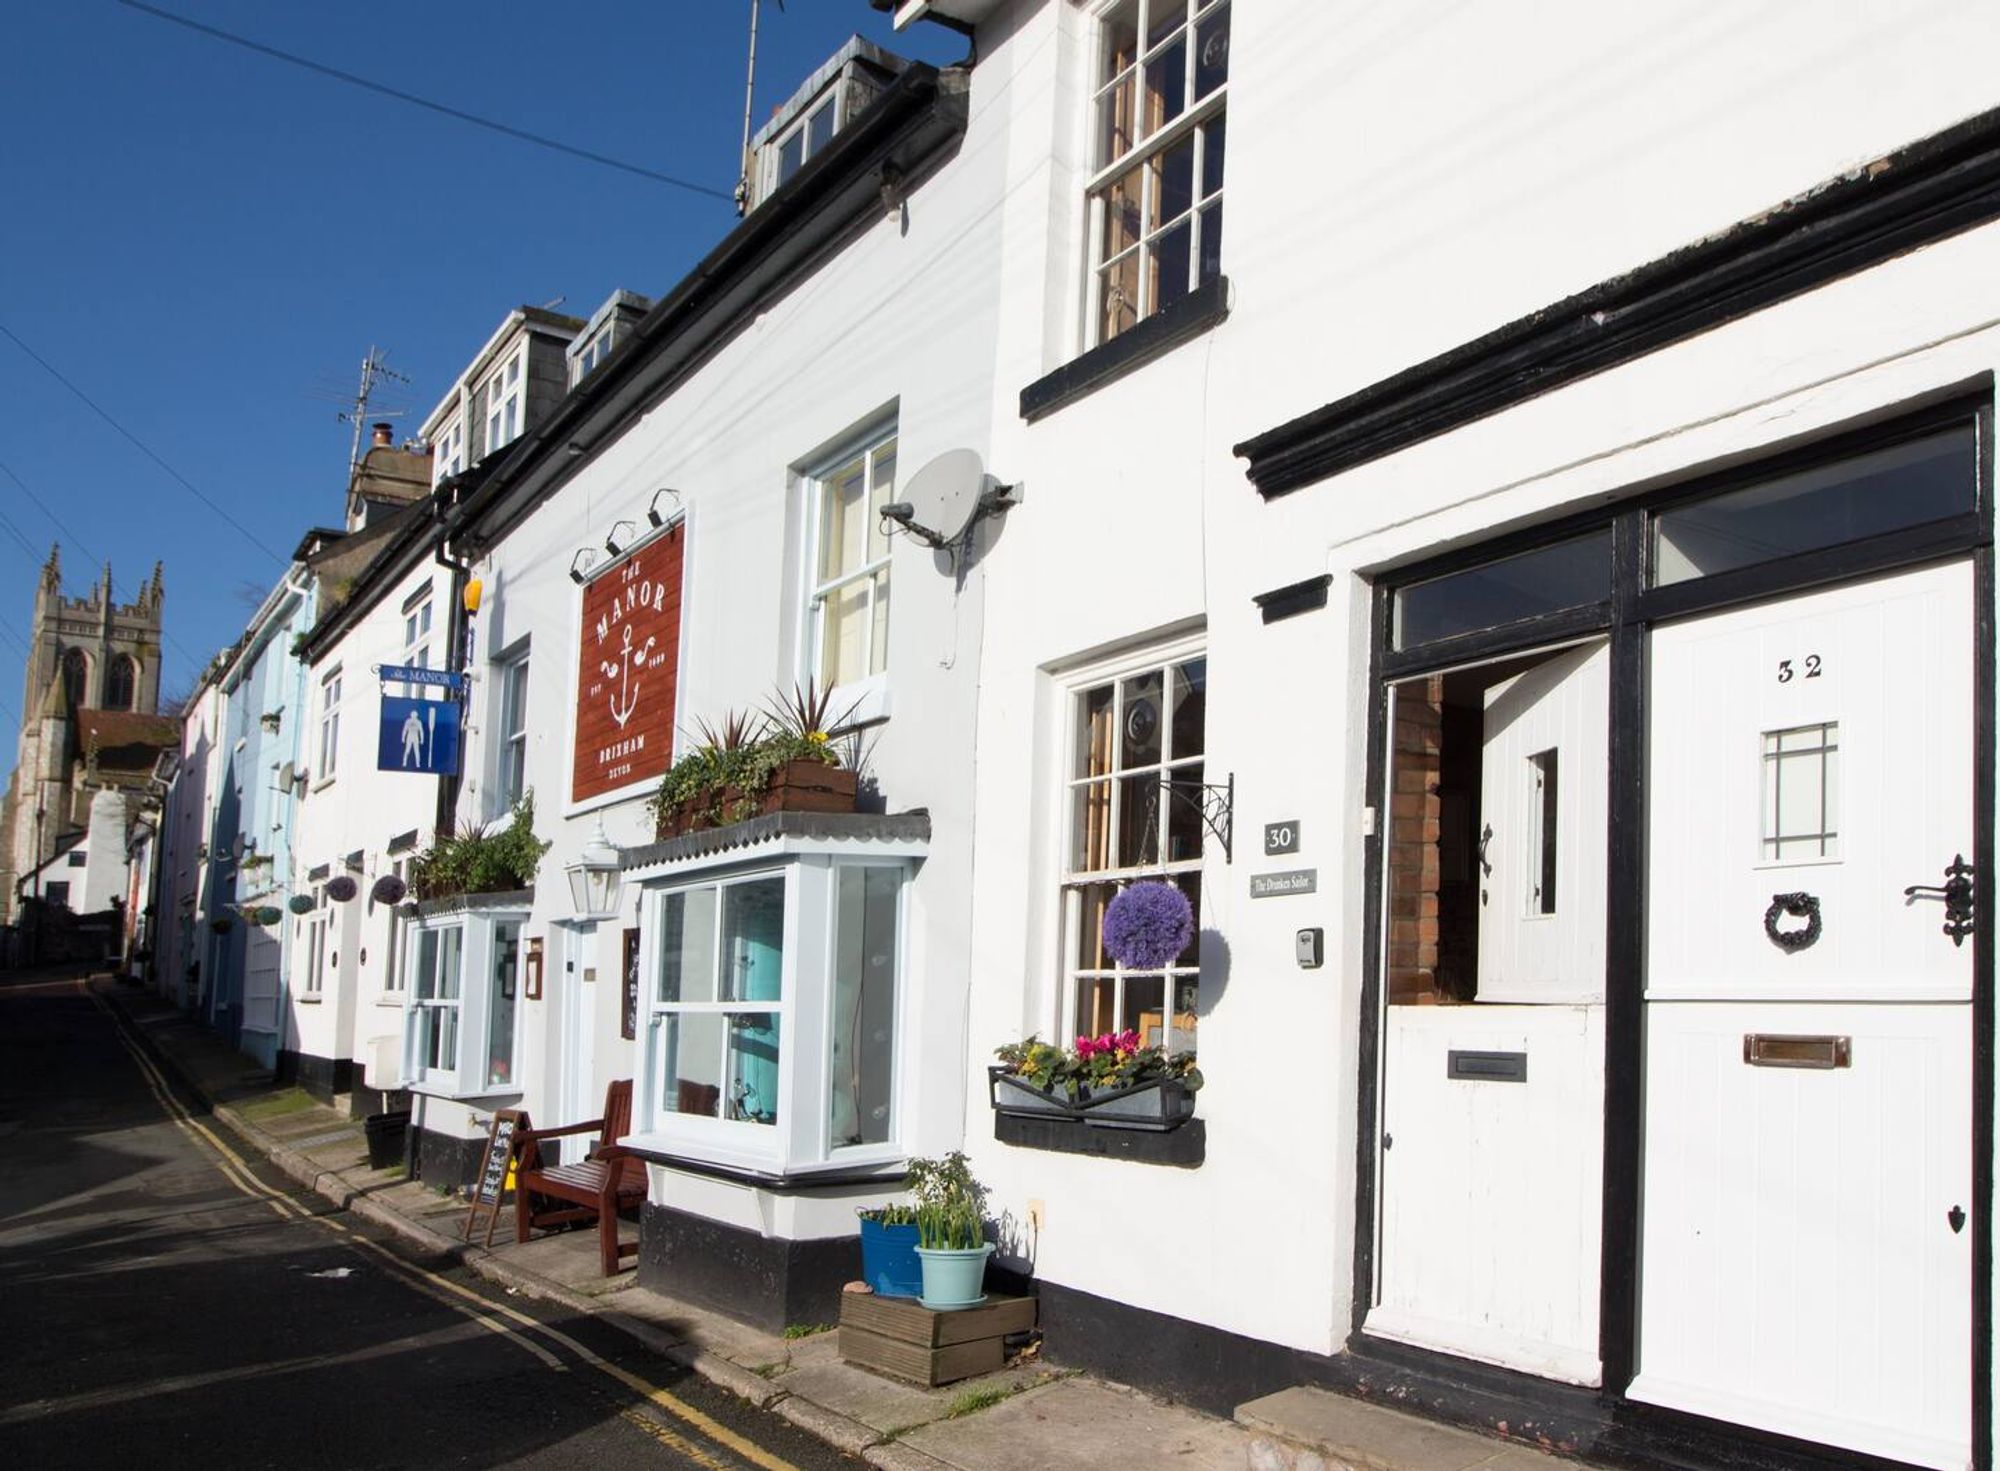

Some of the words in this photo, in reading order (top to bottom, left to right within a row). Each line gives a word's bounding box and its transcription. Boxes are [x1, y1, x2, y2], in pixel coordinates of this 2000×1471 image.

[622, 560, 641, 584] THE
[596, 580, 665, 645] MANOR
[409, 670, 450, 686] MANOR
[1778, 654, 1823, 684] 32
[599, 734, 645, 764] BRIXHAM
[1269, 827, 1292, 848] 30
[1255, 878, 1266, 892] The
[1266, 877, 1290, 891] Drunken
[1291, 874, 1309, 889] Sailor
